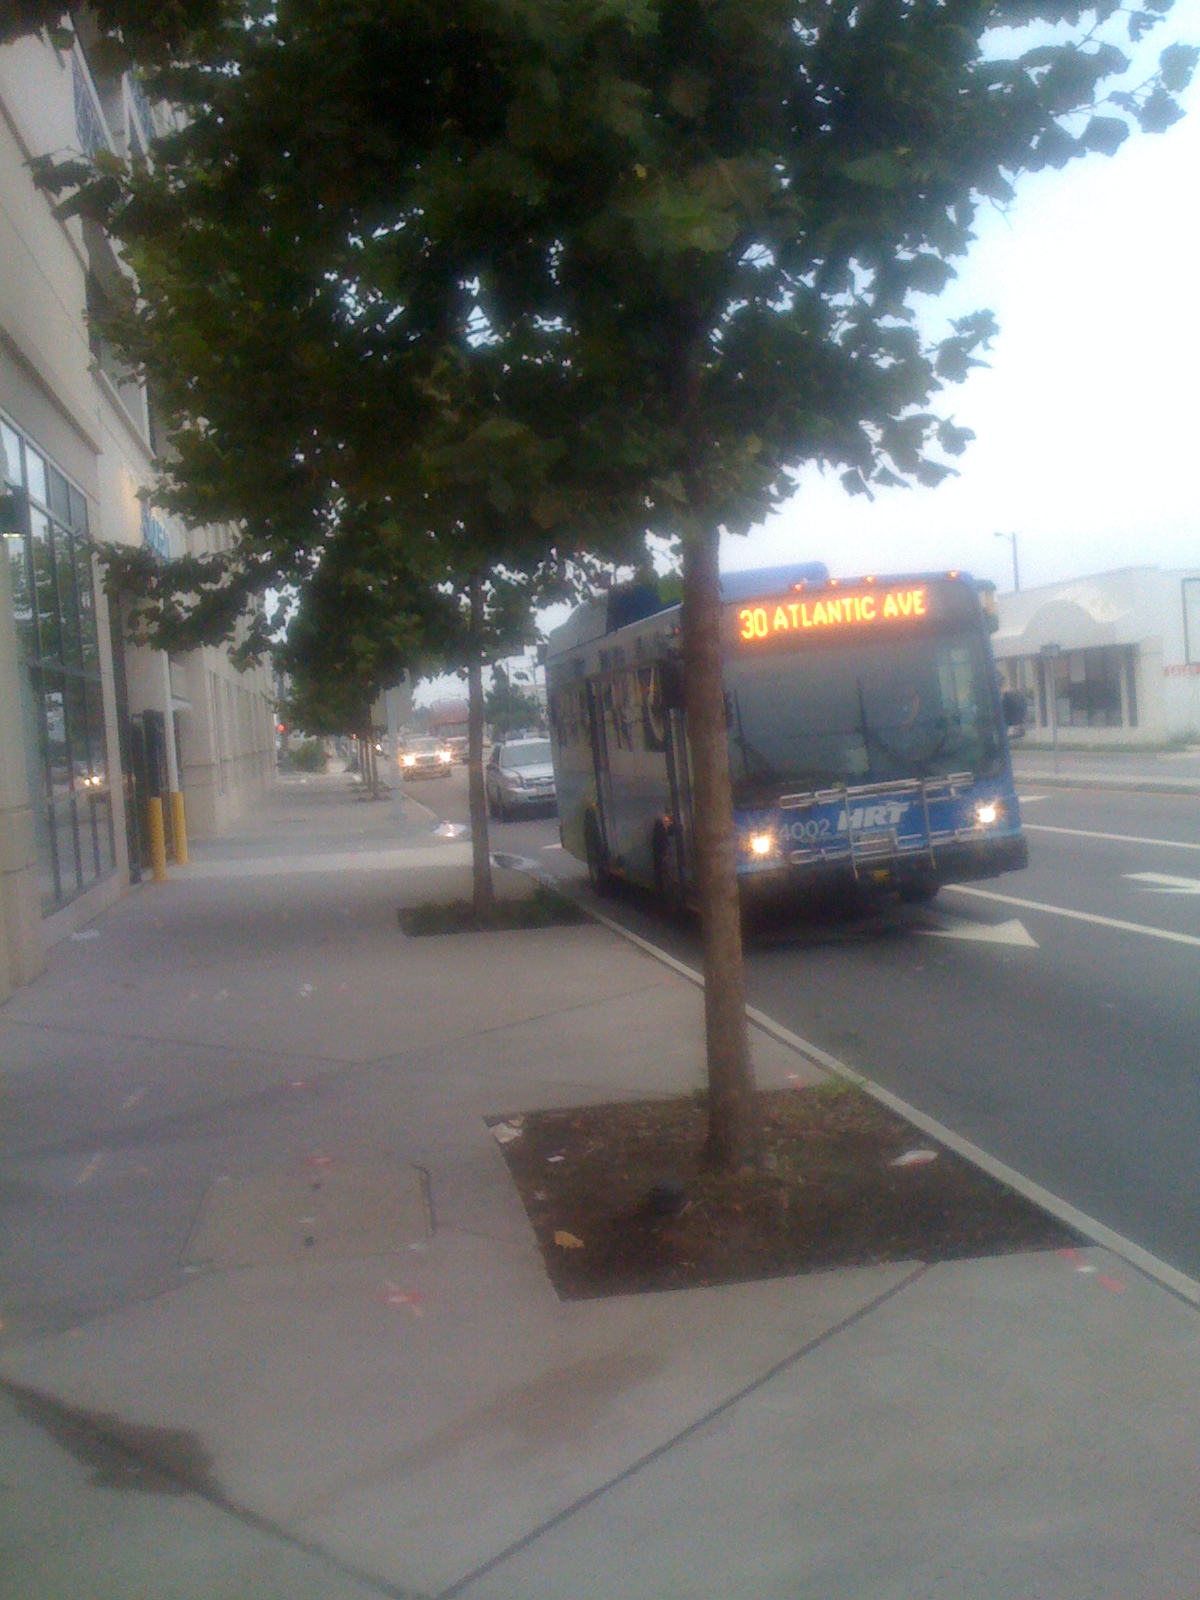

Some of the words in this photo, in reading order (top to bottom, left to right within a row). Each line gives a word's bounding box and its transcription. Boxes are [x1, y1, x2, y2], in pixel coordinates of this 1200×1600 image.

[739, 607, 769, 639] 30
[773, 595, 876, 631] ATLANTIC
[883, 590, 926, 618] AVE
[837, 801, 910, 831] HRT
